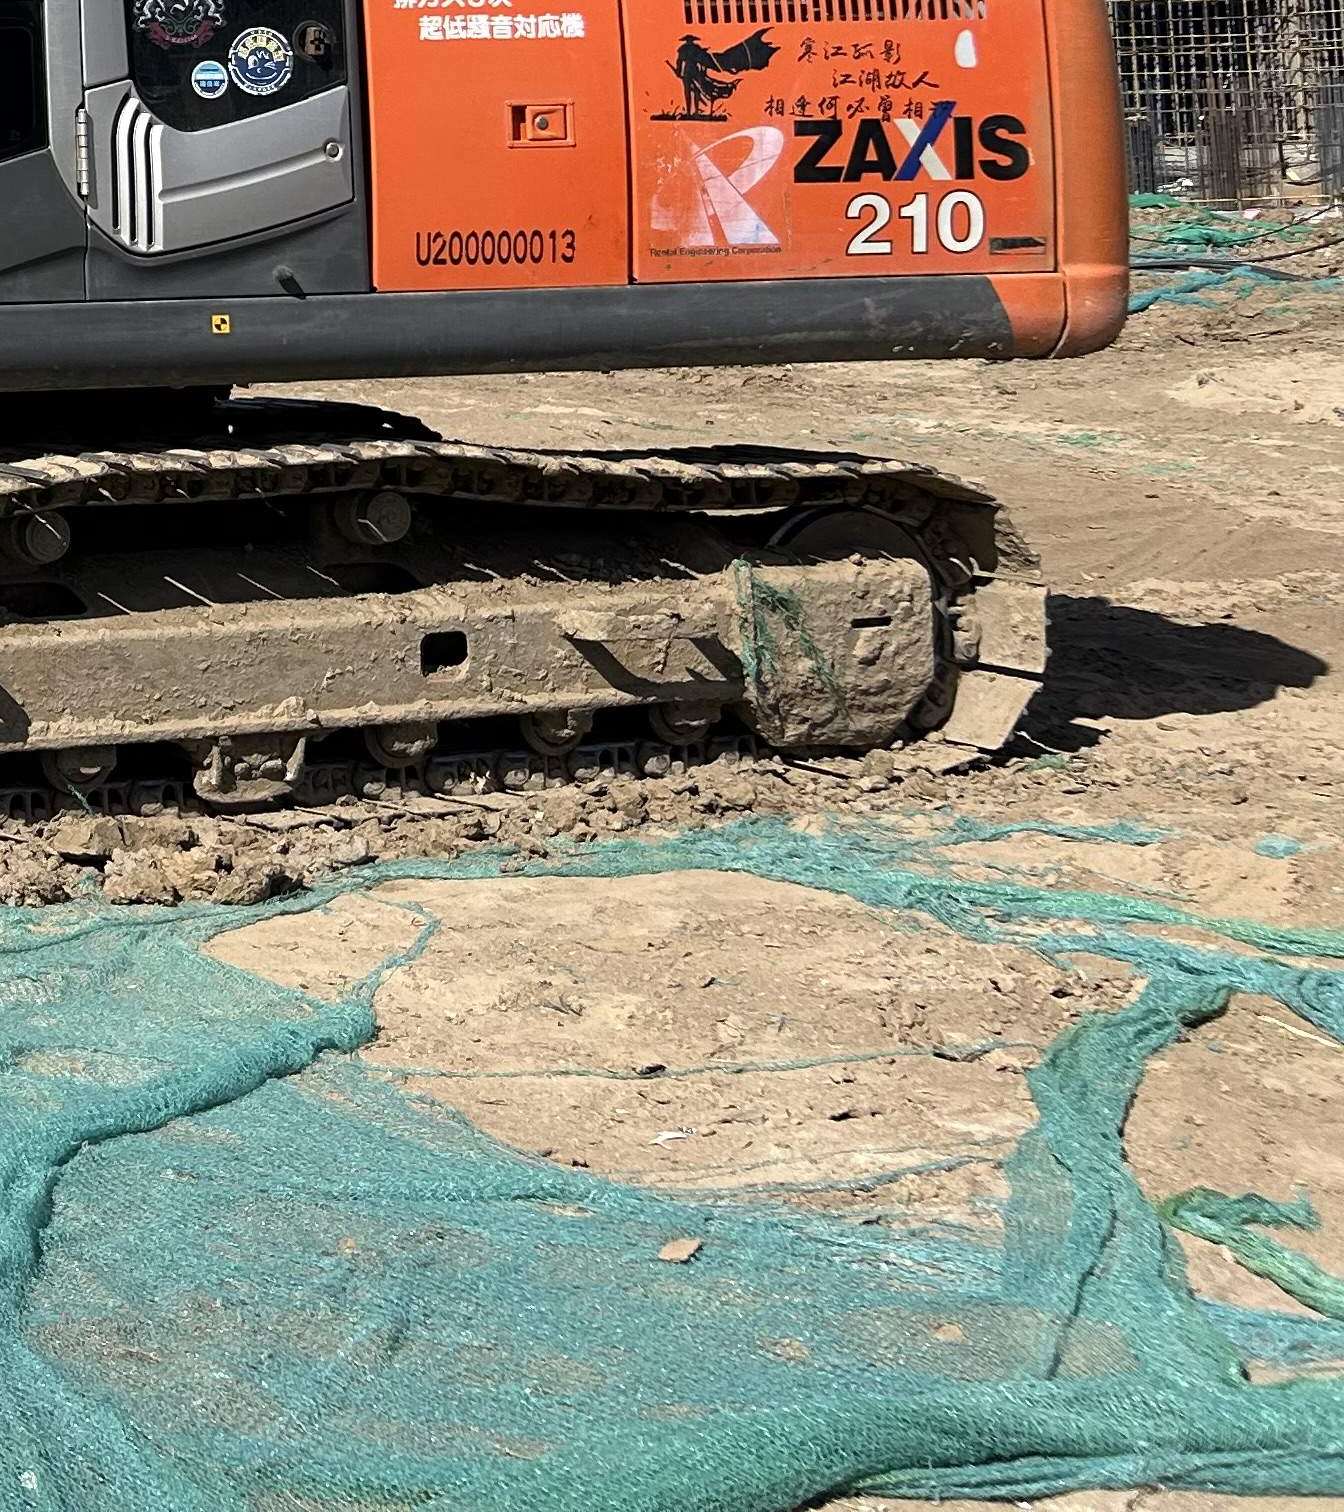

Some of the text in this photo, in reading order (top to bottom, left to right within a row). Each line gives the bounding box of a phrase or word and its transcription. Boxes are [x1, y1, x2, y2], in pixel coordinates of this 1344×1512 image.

[831, 69, 940, 92] 江湖故人
[793, 100, 1031, 184] ZAXIS
[845, 189, 986, 256] 210
[416, 229, 576, 266] U200000013
[732, 246, 782, 256] Corporation
